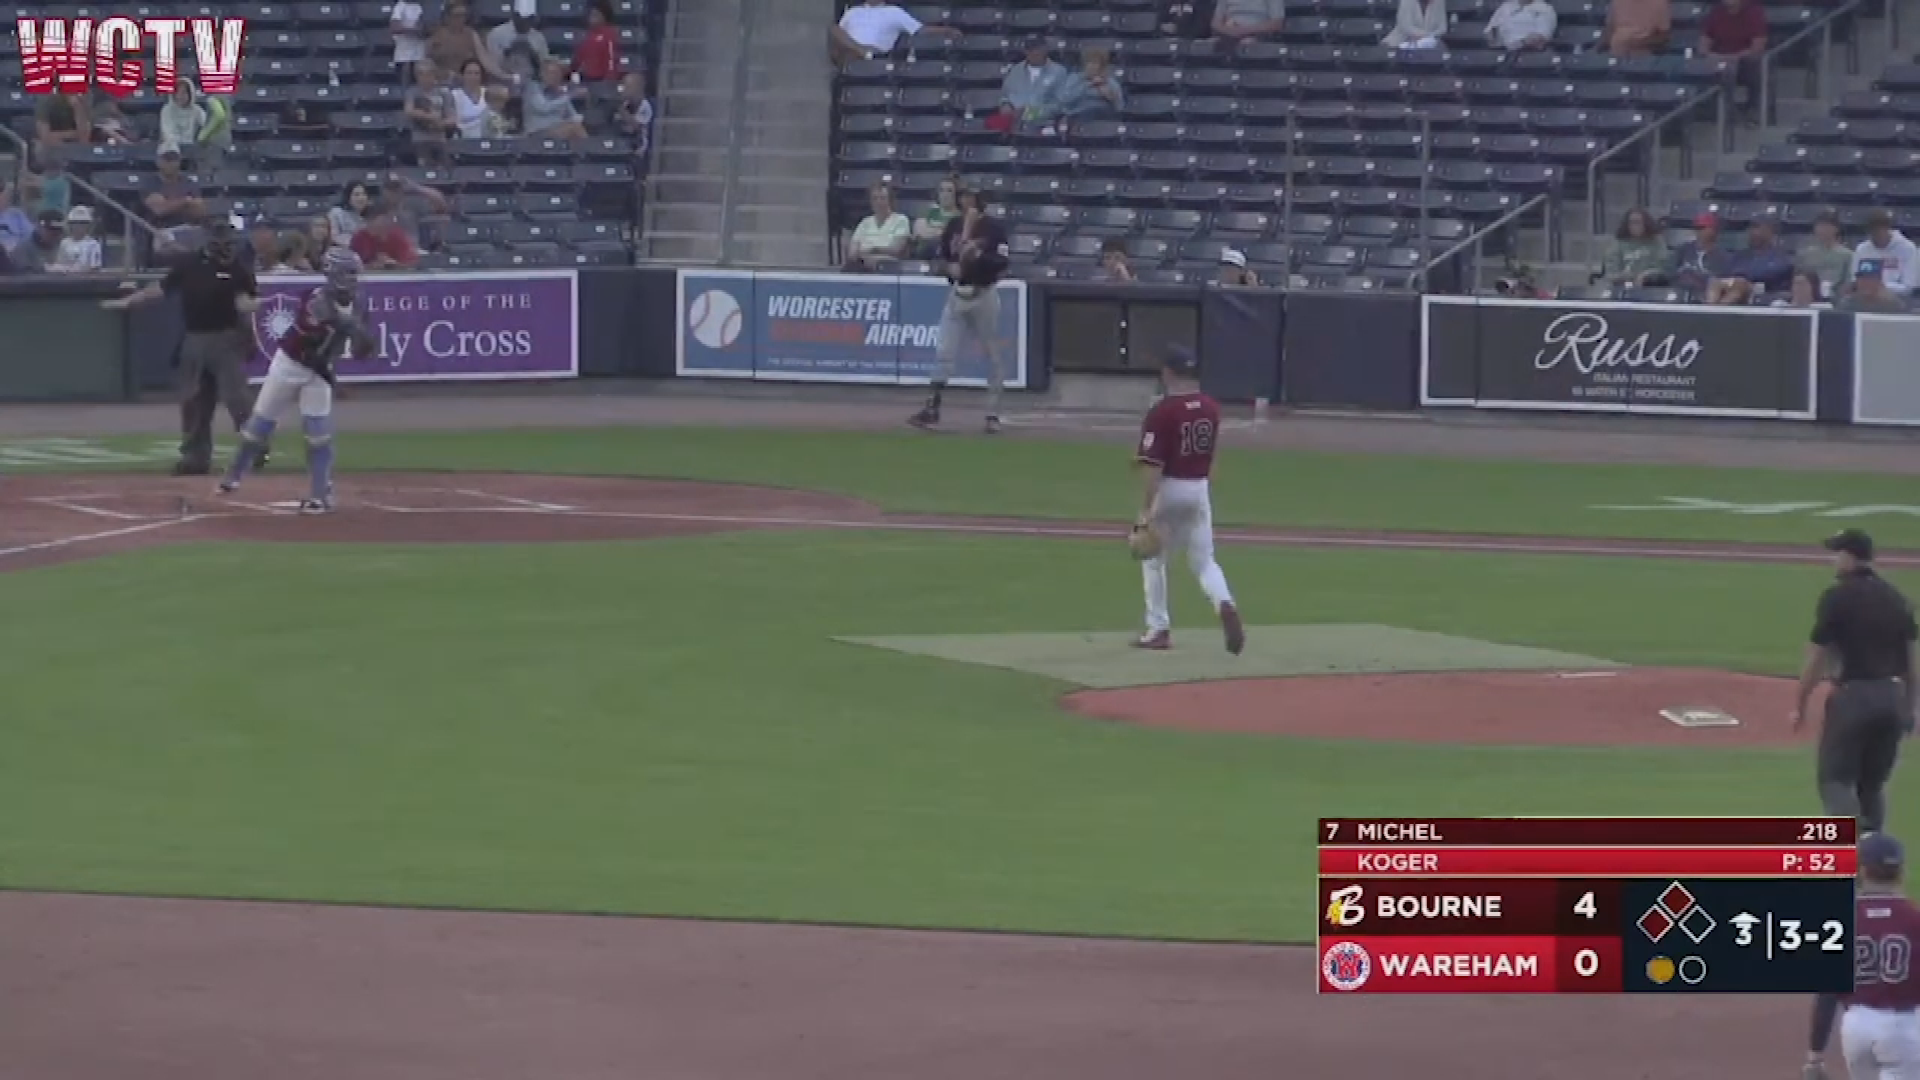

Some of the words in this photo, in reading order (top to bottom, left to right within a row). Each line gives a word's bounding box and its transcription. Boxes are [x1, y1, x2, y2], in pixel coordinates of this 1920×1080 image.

[368, 295, 430, 311] LEGE
[442, 295, 471, 311] OF
[485, 293, 532, 309] THE
[767, 295, 892, 321] WORCESTER
[423, 320, 532, 358] Cross
[864, 323, 938, 347] AIRPOR
[1535, 312, 1702, 373] Russo
[1181, 418, 1213, 456] 18
[1855, 934, 1911, 984] 20
